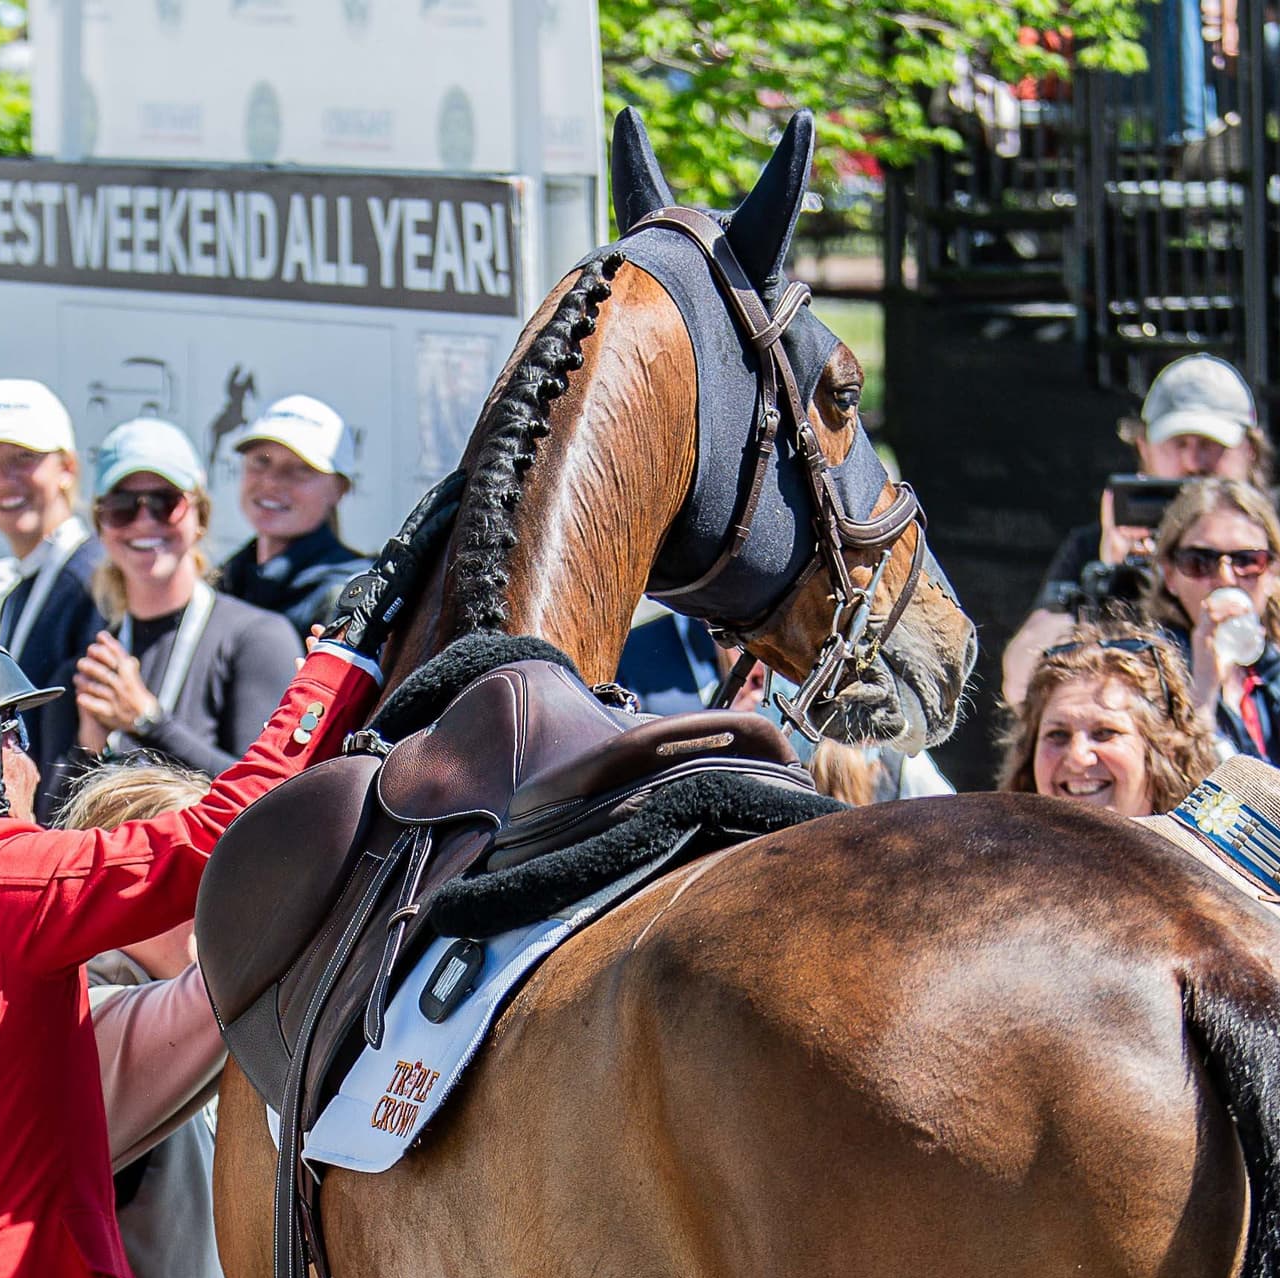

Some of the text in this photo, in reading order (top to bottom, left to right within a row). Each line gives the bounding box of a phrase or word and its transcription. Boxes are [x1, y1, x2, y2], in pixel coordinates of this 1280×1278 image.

[64, 182, 279, 281] WEEKEND
[281, 193, 368, 287] ALL
[367, 196, 512, 297] YEAR!
[371, 1095, 419, 1139] CROWN
